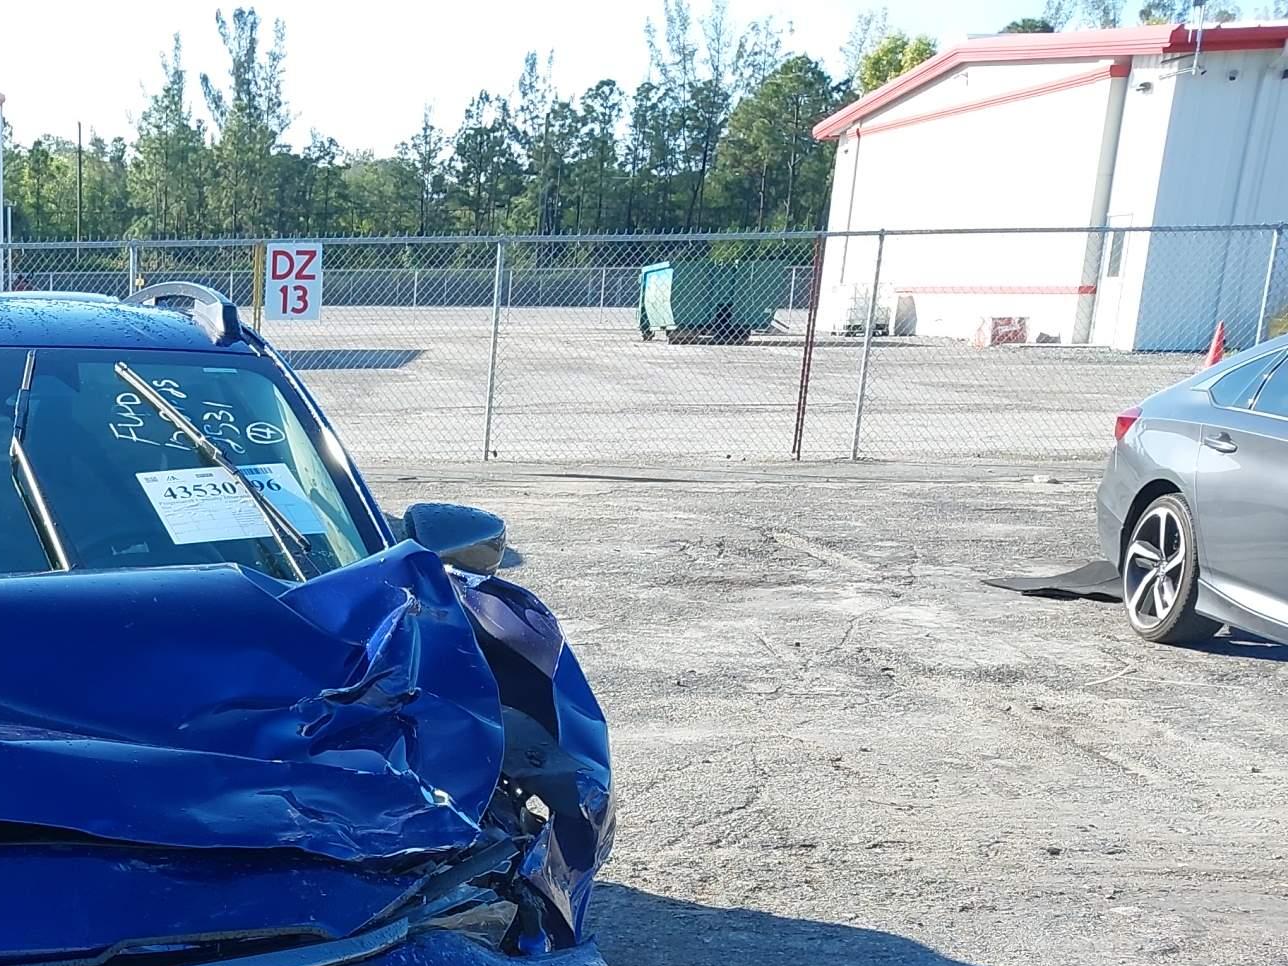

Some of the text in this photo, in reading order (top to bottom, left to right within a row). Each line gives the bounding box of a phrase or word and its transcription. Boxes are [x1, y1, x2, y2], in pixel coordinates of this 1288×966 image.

[272, 250, 317, 280] DZ
[279, 285, 309, 314] 13
[163, 478, 282, 500] 4353096
